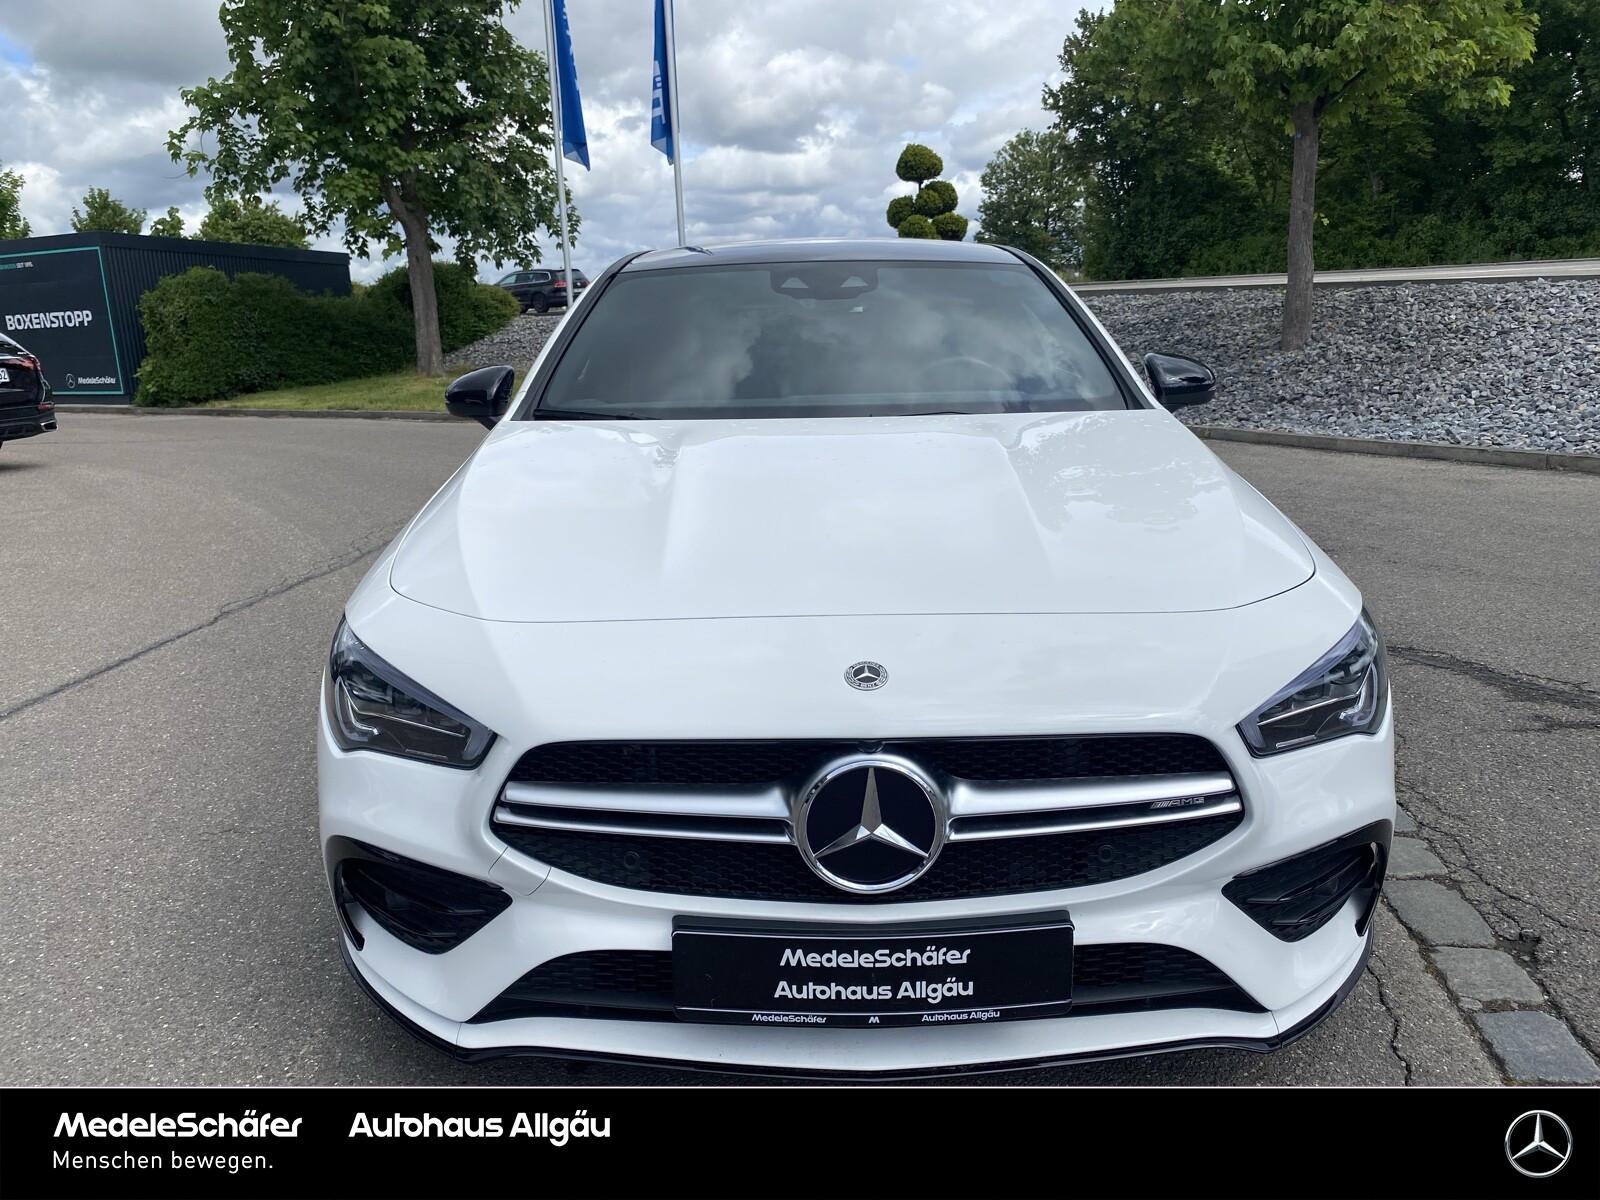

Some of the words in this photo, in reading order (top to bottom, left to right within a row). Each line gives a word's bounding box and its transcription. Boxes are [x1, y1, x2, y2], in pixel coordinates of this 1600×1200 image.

[5, 310, 93, 330] BOXENSTOPP
[780, 946, 970, 968] MedeleSchäfer
[774, 980, 892, 1000] Autohaus
[896, 977, 974, 1003] Allgäu
[751, 1013, 827, 1024] MedeleSchäfer
[921, 1012, 968, 1022] Autohaus
[969, 1010, 1000, 1021] Allgäu
